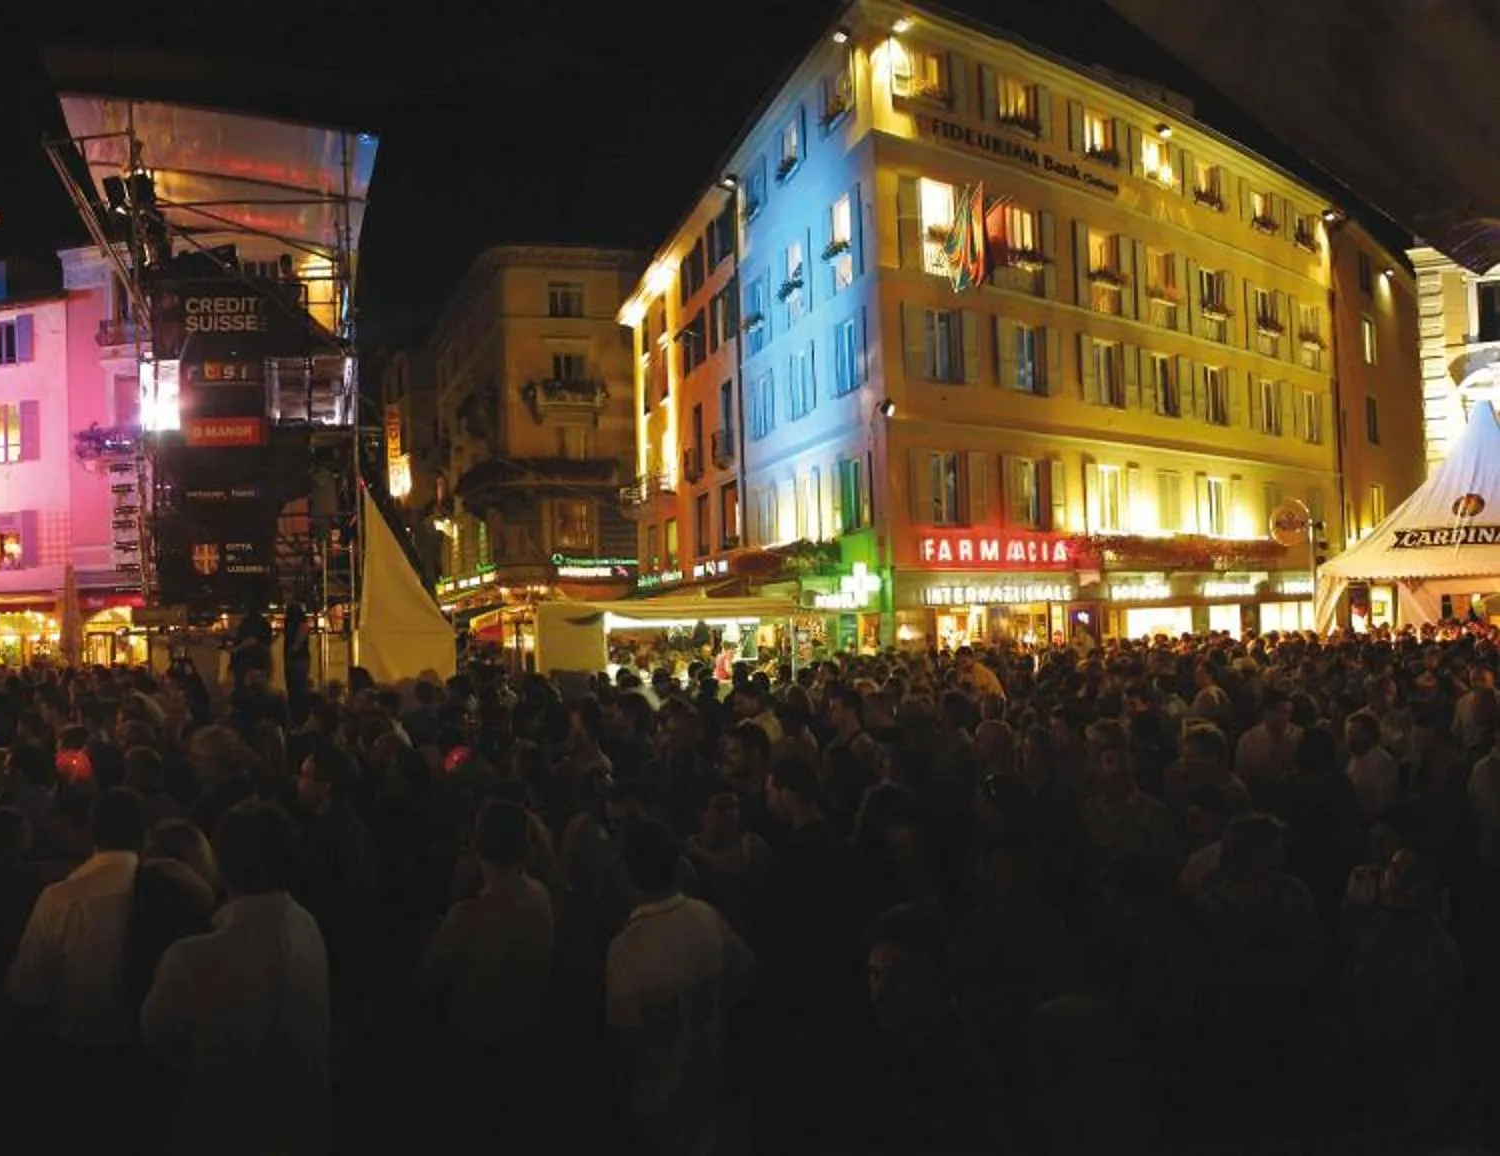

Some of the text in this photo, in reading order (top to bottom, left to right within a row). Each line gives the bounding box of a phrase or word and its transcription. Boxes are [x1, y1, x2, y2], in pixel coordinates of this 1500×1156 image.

[185, 297, 258, 314] CREDIT
[184, 314, 258, 333] SUISSE
[924, 538, 1067, 562] FARMACIA
